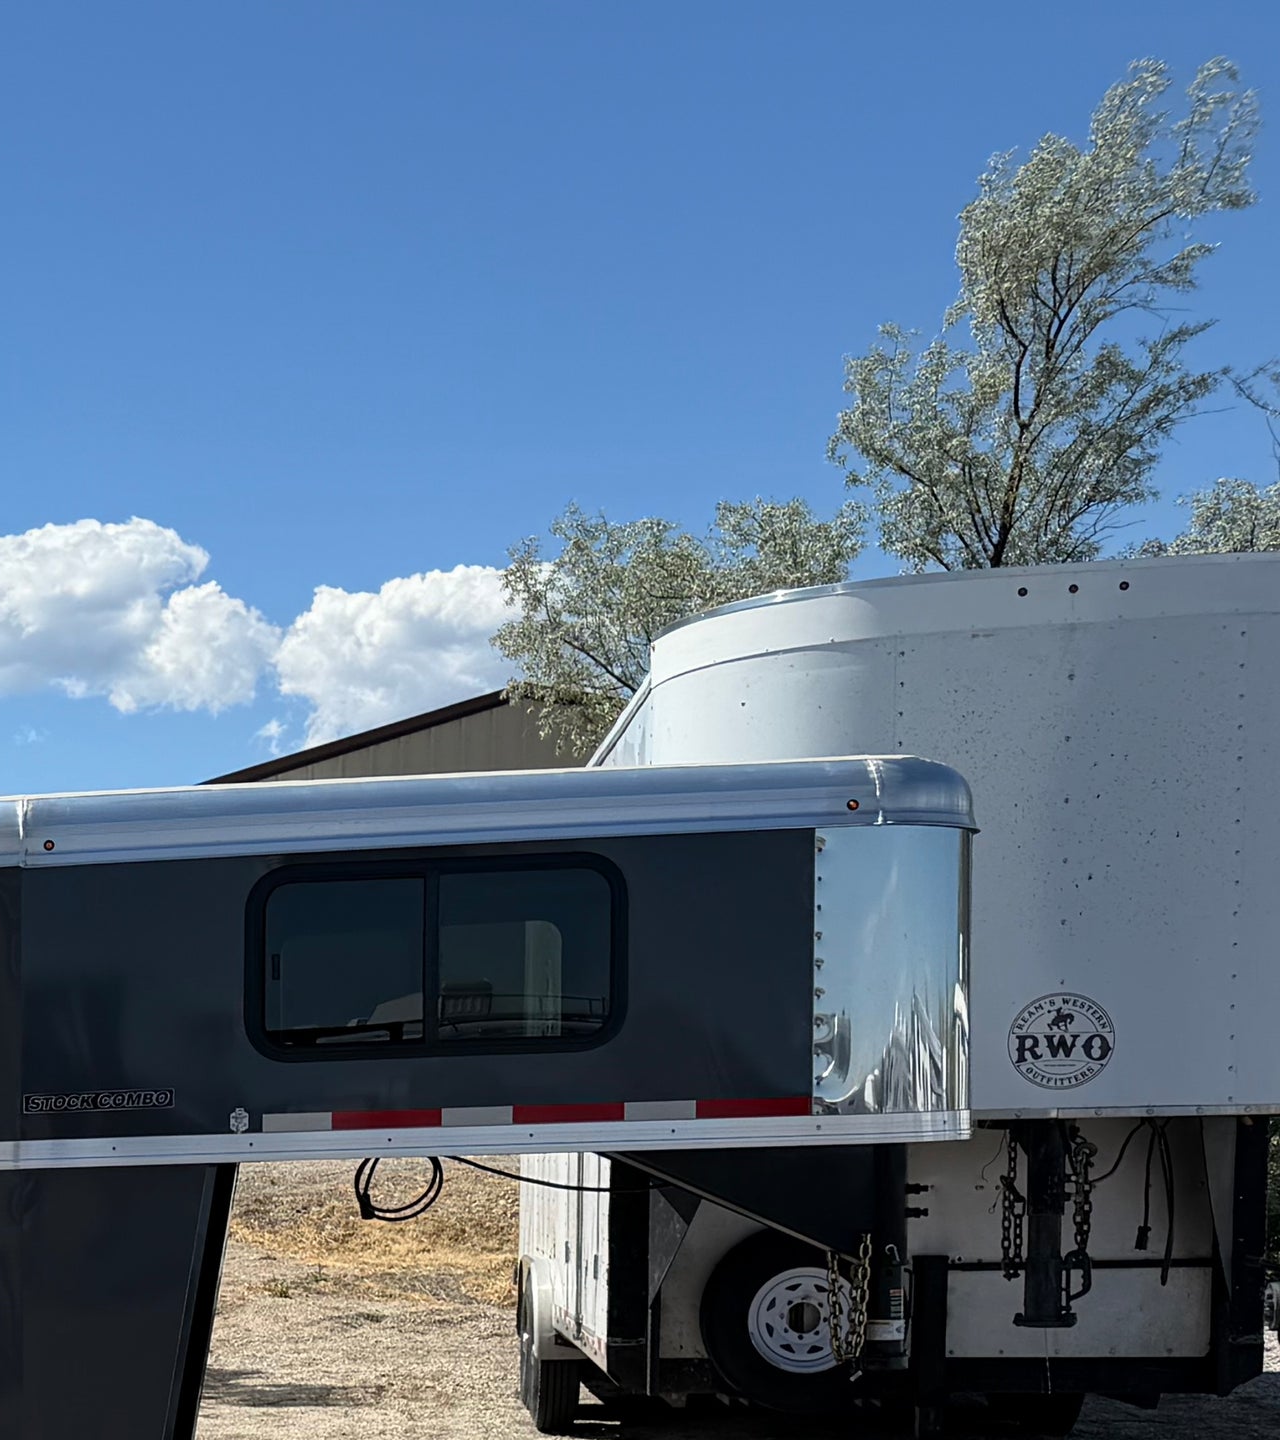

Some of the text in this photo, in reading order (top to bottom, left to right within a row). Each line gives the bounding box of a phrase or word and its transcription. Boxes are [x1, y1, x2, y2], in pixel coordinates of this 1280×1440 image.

[1016, 997, 1109, 1031] REAM'S WESTERN
[1015, 1033, 1112, 1064] RWO
[1025, 1066, 1095, 1086] OUTFITTERS
[28, 1091, 171, 1111] STOCK COMBO
